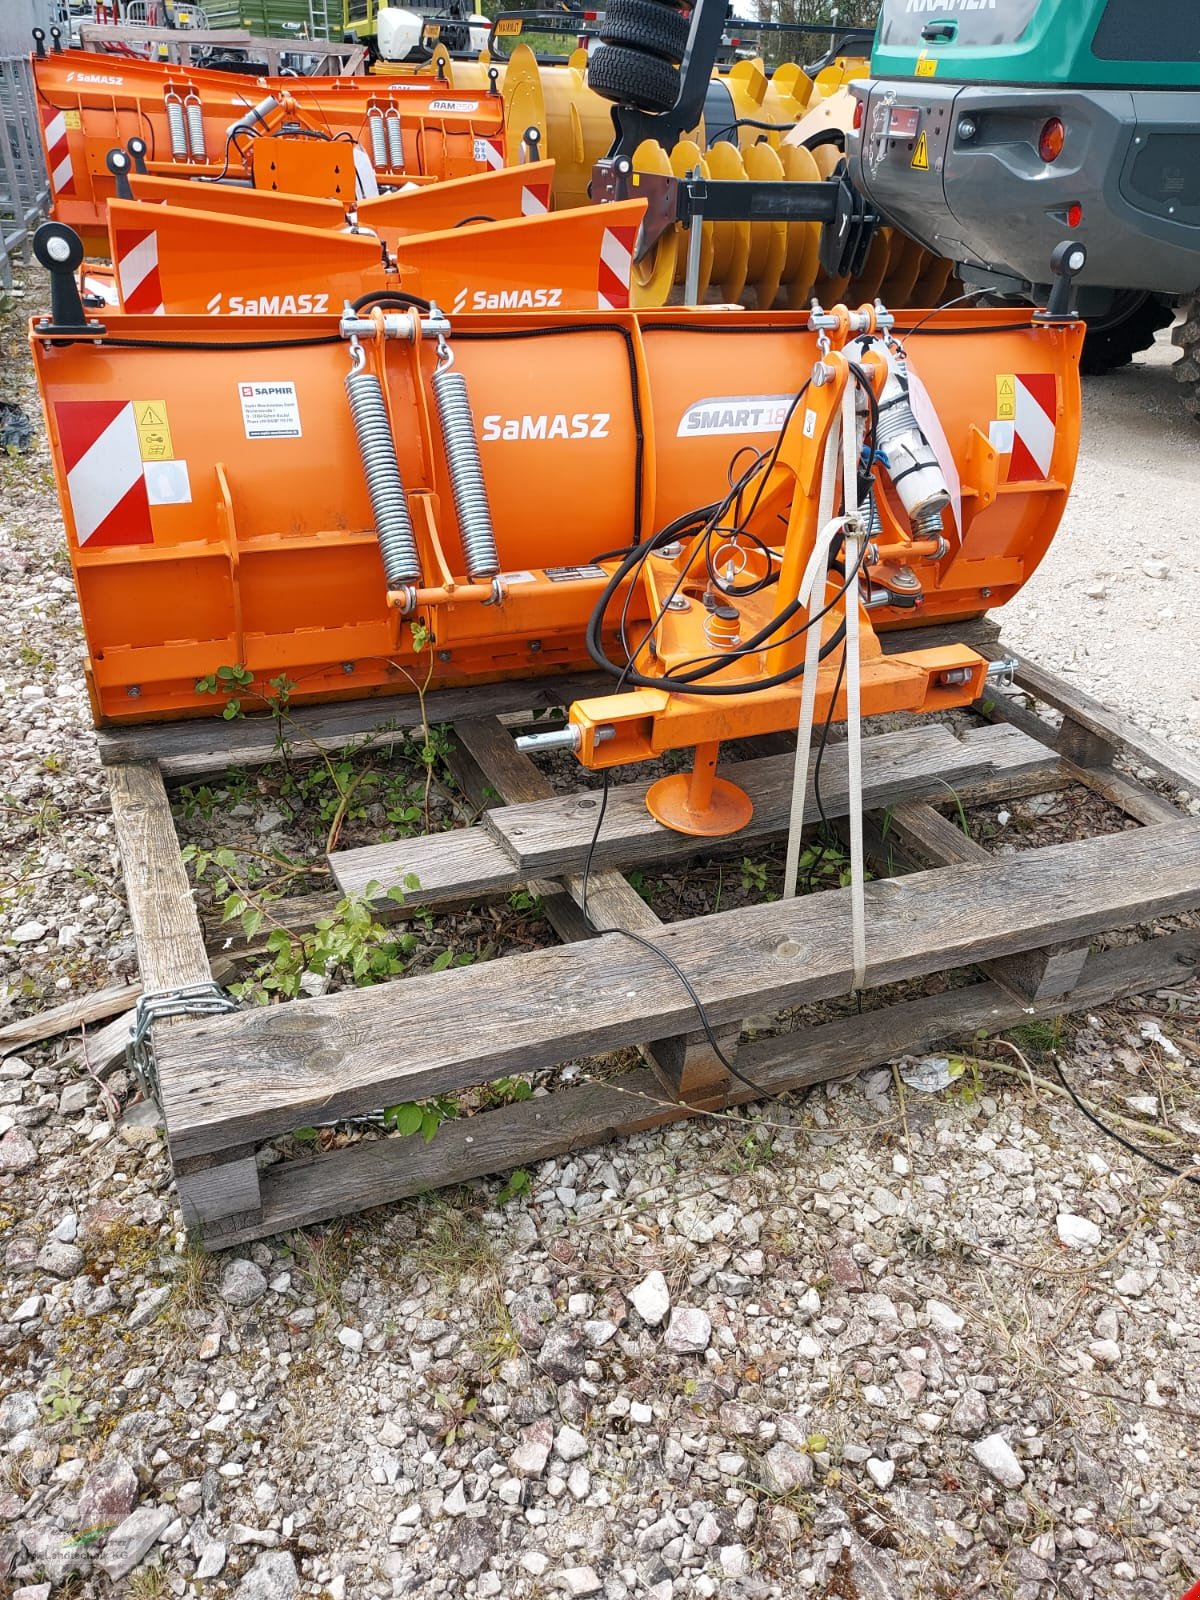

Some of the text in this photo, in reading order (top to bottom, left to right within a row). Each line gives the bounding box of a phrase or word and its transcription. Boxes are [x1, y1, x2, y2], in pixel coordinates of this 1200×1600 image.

[77, 73, 124, 86] SaMASZ
[228, 293, 329, 315] SaMASZ
[472, 289, 563, 310] SaMASZ
[255, 387, 293, 395] SAPHIR
[482, 413, 611, 441] SaMASZ
